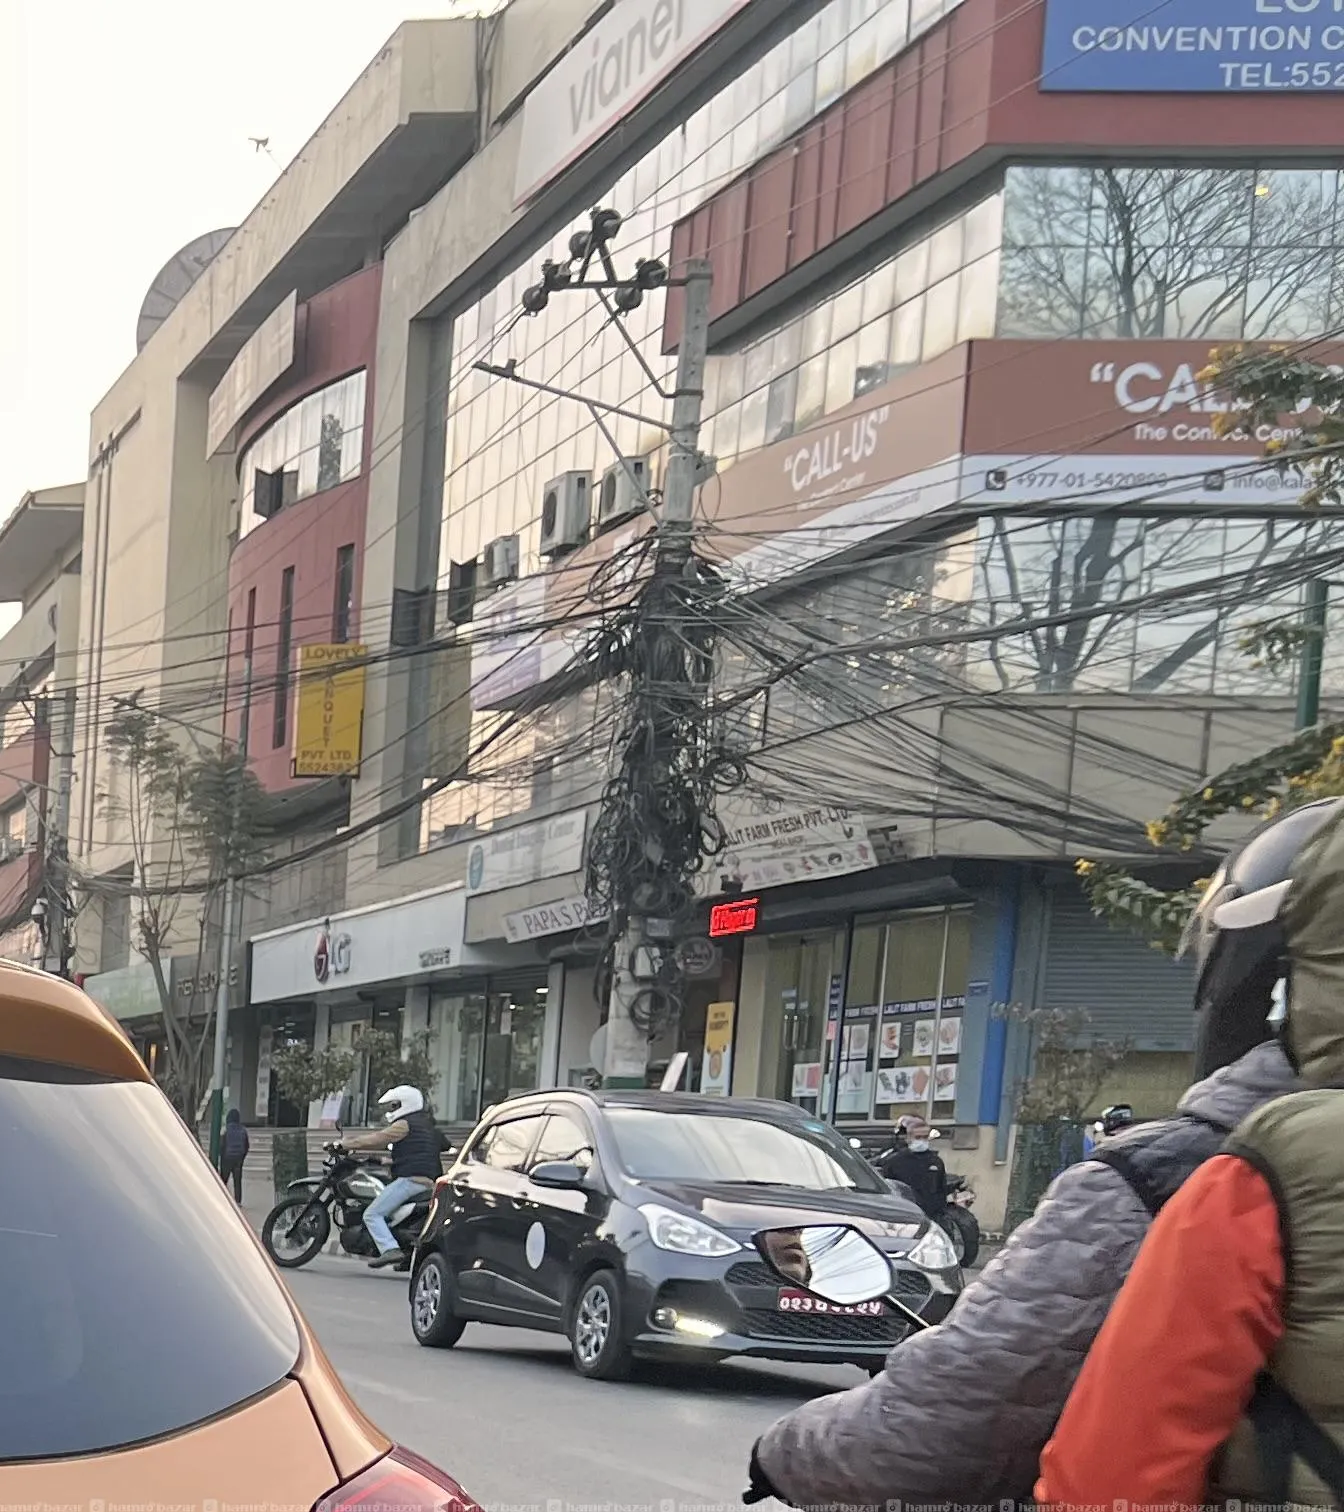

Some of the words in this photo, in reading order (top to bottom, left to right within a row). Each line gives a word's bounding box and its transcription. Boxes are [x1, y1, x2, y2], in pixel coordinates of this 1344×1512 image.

[1072, 25, 1310, 51] CONVENTION
[1134, 424, 1167, 441] The
[322, 663, 335, 749] ANQUET
[301, 750, 325, 760] PVT
[330, 750, 352, 760] LTD
[745, 824, 771, 844] FARM
[771, 814, 804, 836] FRESH
